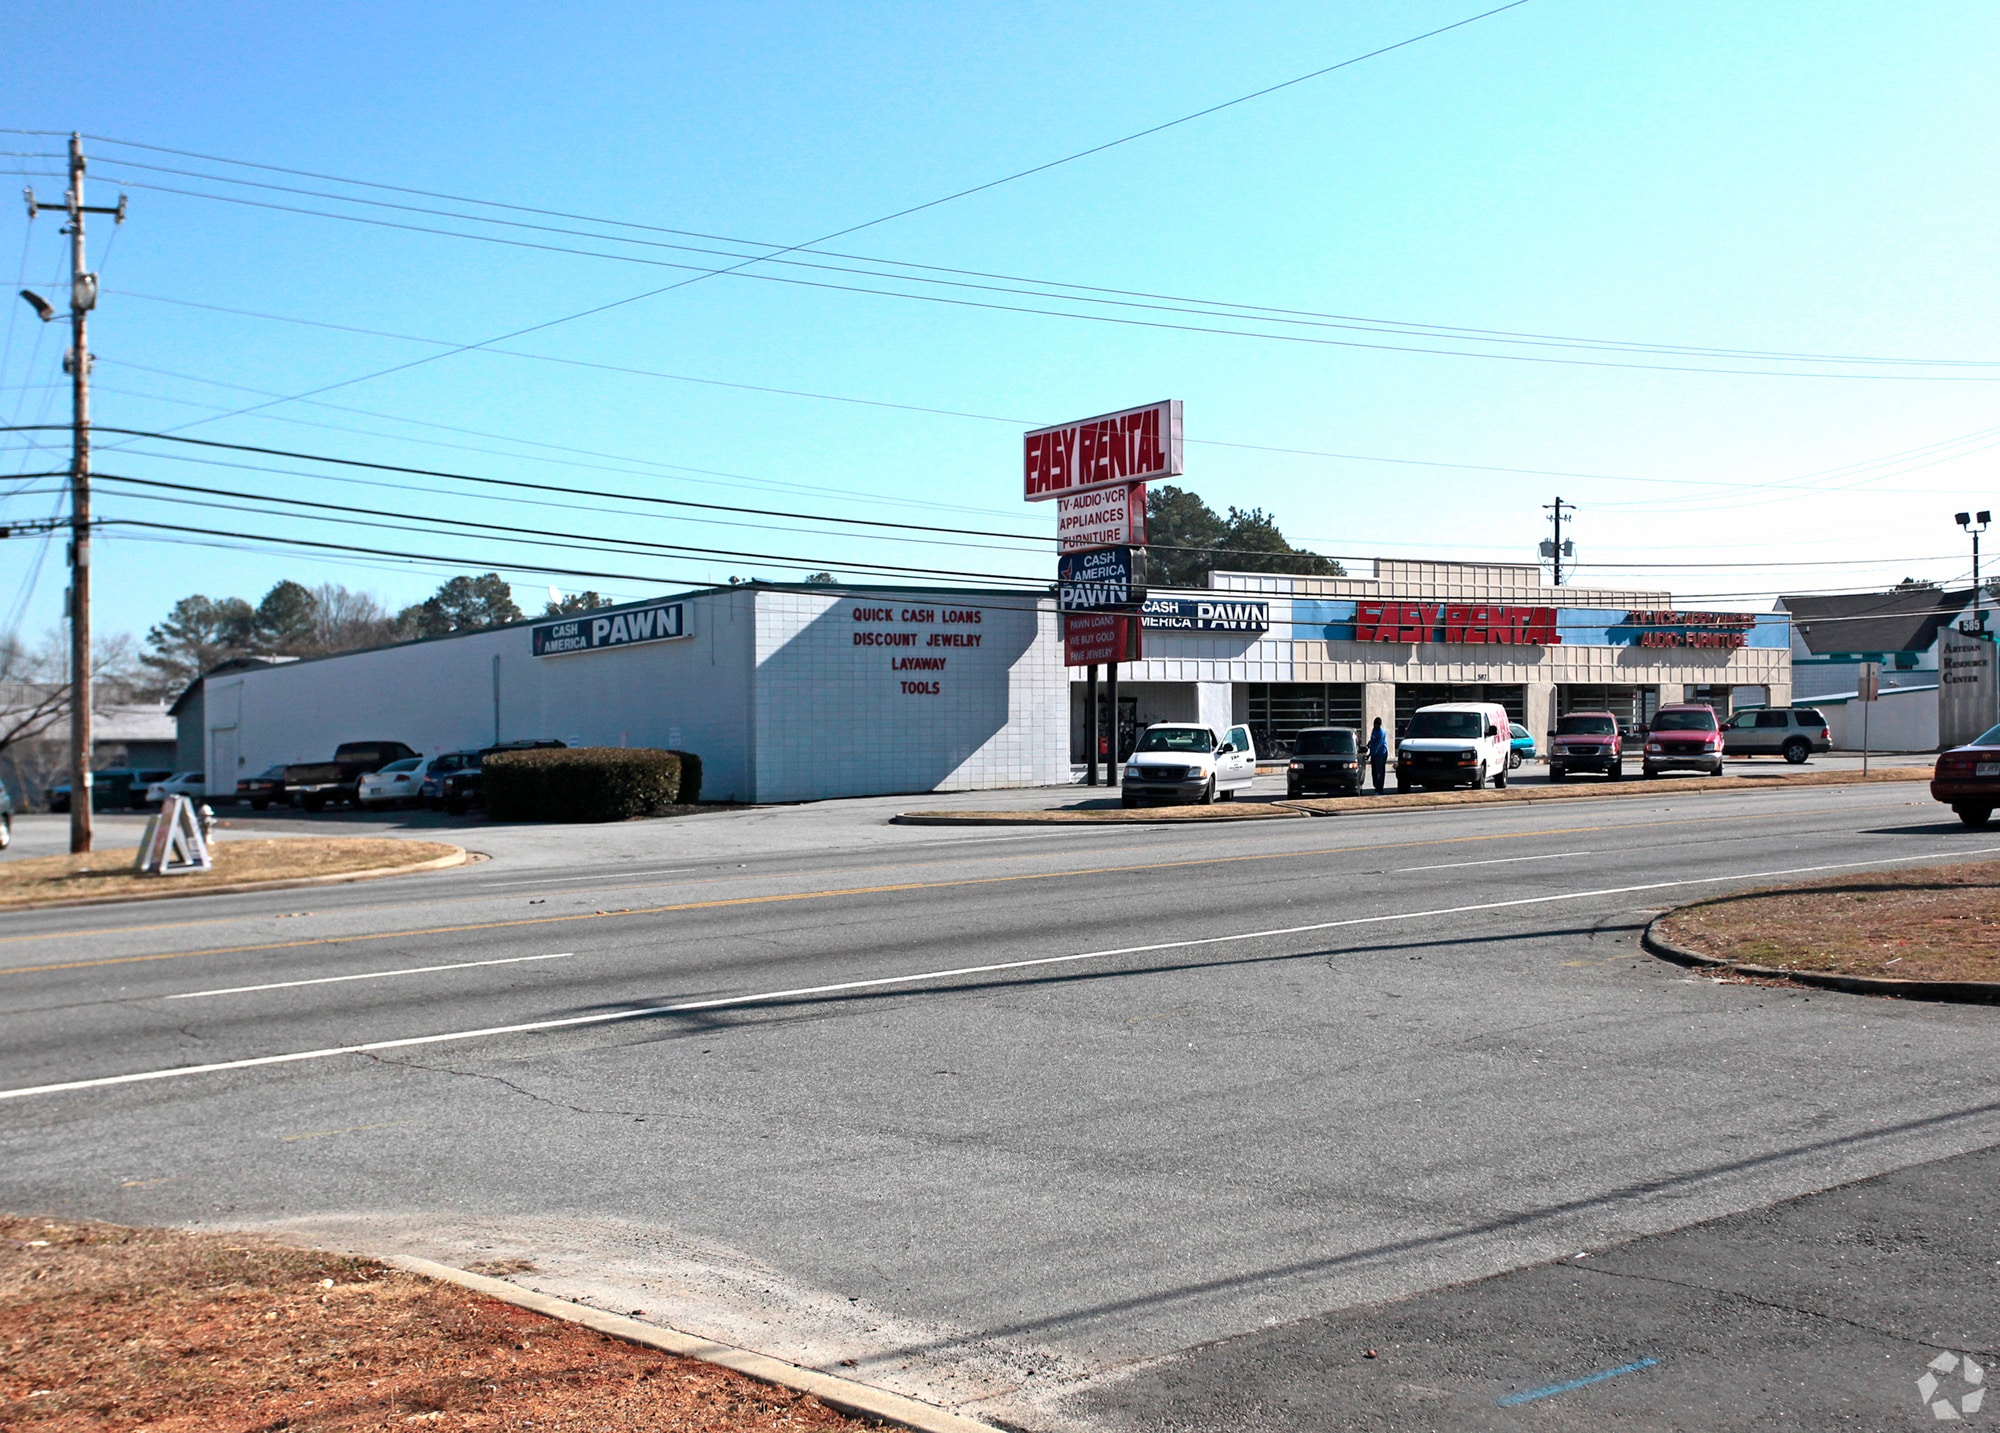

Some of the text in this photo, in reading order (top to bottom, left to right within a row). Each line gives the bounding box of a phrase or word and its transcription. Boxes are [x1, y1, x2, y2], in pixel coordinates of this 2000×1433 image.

[1026, 408, 1165, 495] EASY RENTAL
[1060, 508, 1124, 530] APPLIANCES
[1063, 528, 1121, 549] FURNITURE
[1083, 551, 1116, 567] CASH
[1074, 564, 1126, 582] AMERICA
[1060, 577, 1128, 610] PAWN
[1141, 601, 1179, 614] CASH
[852, 608, 982, 623] QUICK CASH LOANS
[1070, 616, 1114, 629] PAWN LOANS
[1141, 616, 1192, 628] MERICA
[1197, 603, 1268, 630] PAWN
[1356, 601, 1562, 644] EASY RENTAL
[552, 623, 578, 638] CASH
[592, 607, 677, 646] PAWN
[1963, 620, 1980, 631] 585
[544, 636, 587, 652] AMERICA
[853, 633, 982, 647] DISCOUNT JEWELRY
[1070, 631, 1115, 645] WE BUY GOLD
[1087, 647, 1113, 659] JEWELRY
[892, 657, 946, 671] LAYAWAY
[900, 681, 940, 694] TOOLS
